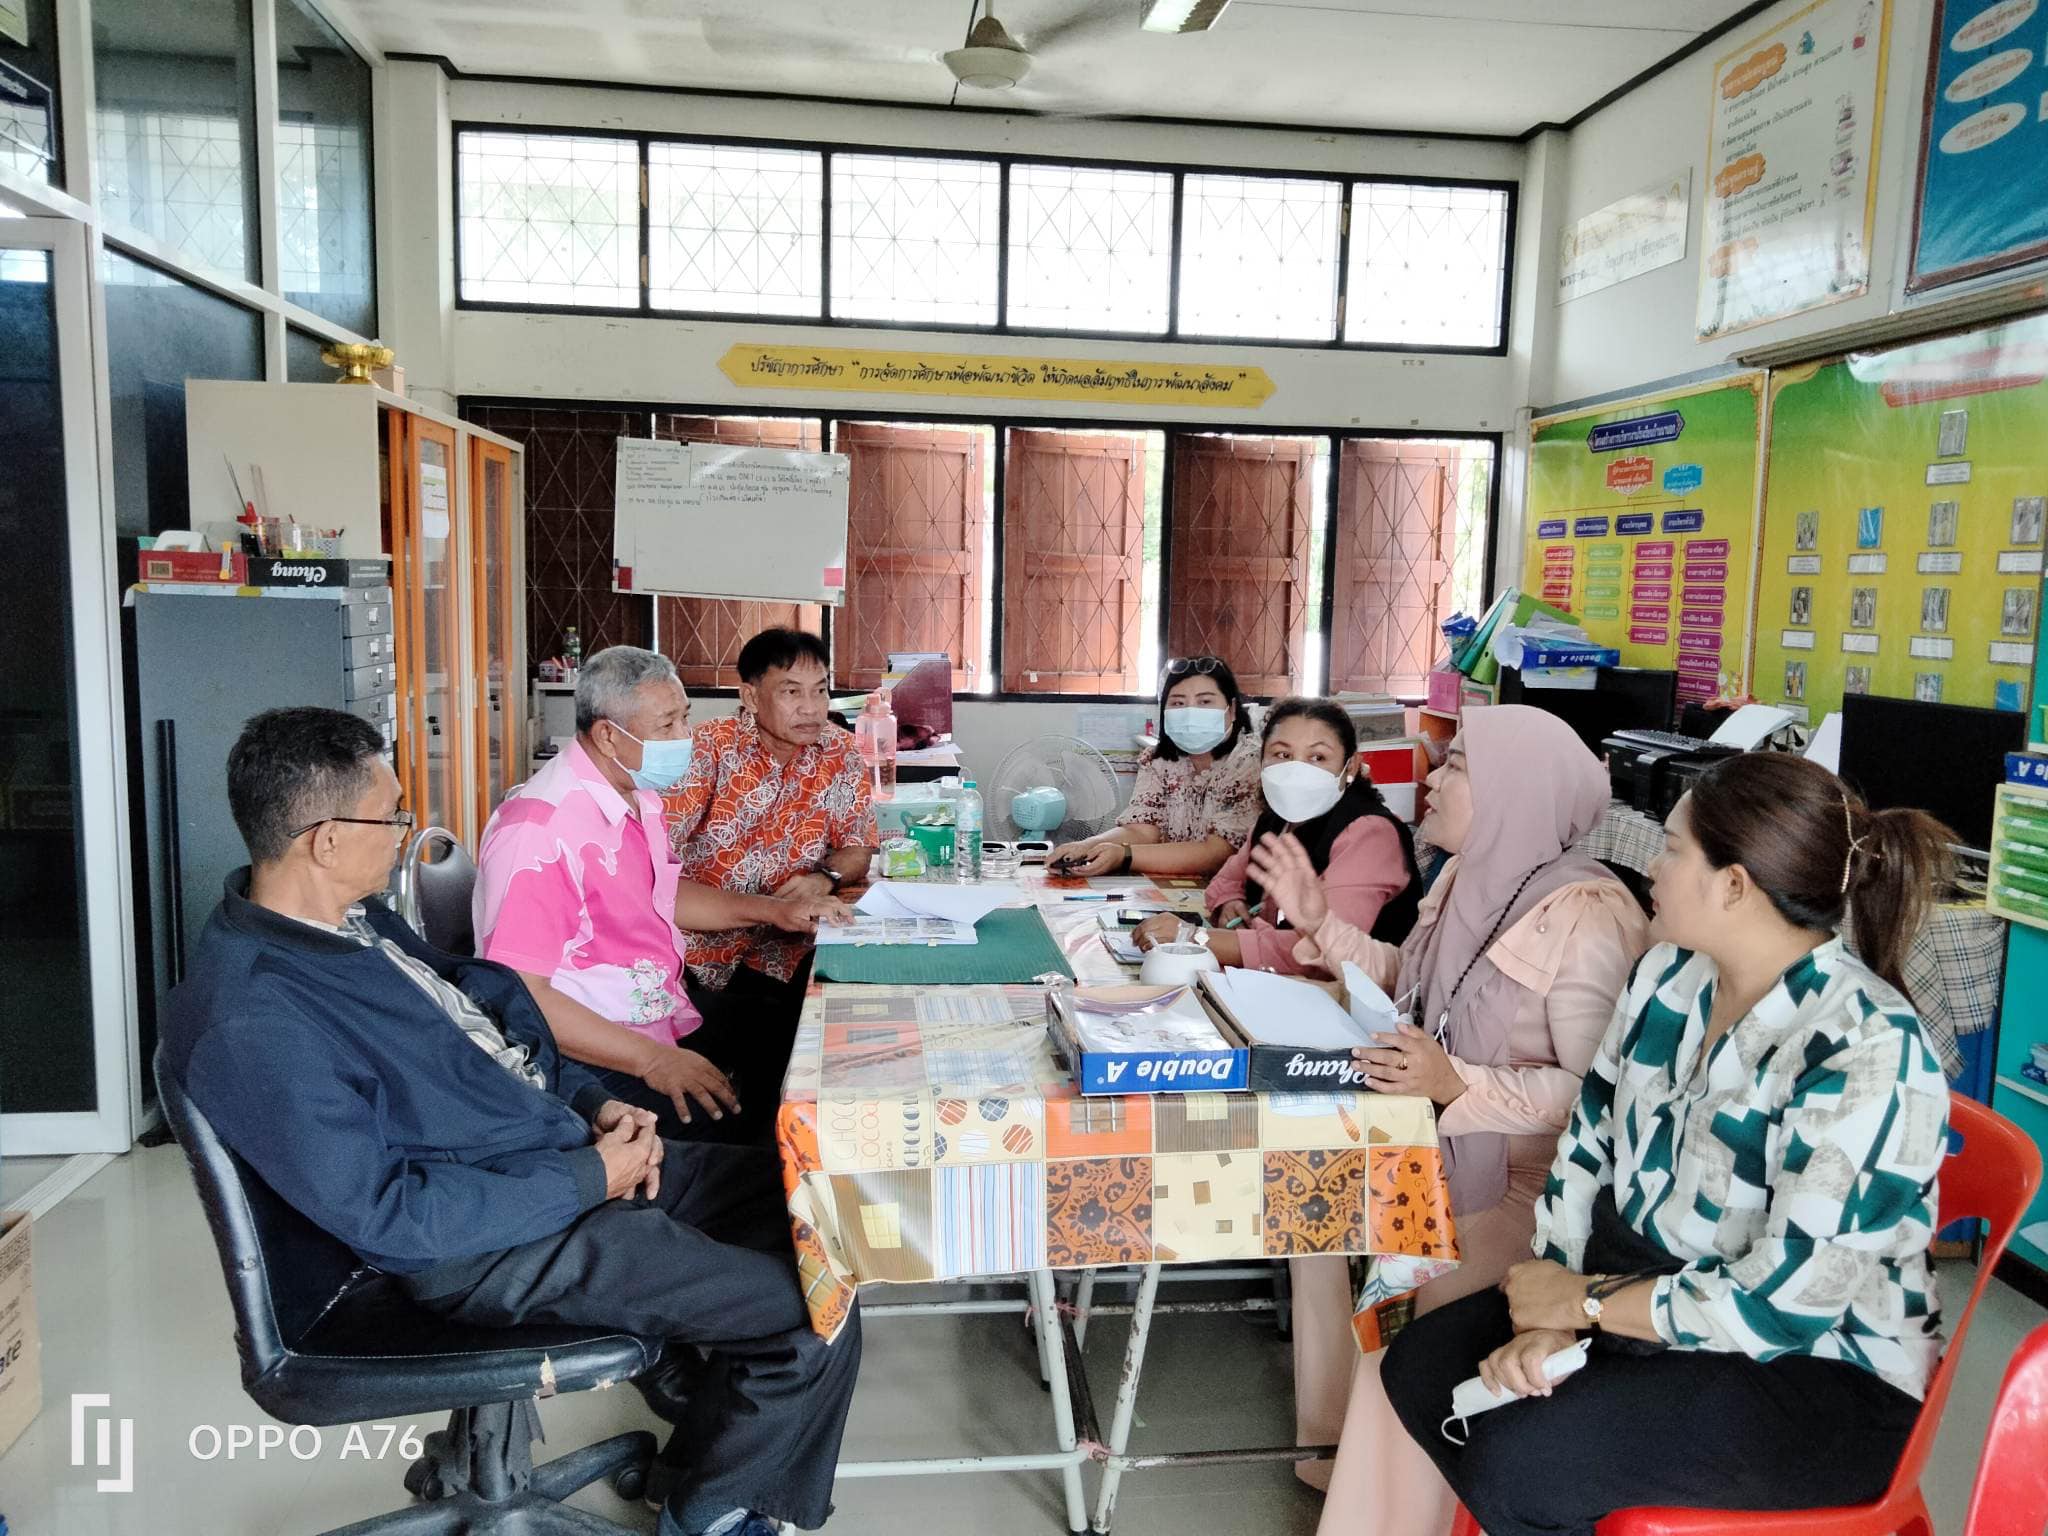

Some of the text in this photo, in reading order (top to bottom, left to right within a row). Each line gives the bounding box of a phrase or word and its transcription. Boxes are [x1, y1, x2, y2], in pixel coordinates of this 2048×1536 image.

[751, 354, 844, 377] ปรัชญาการศึกษา
[271, 561, 328, 583] Chang
[1569, 654, 1601, 664] Double
[1136, 1057, 1234, 1081] Double
